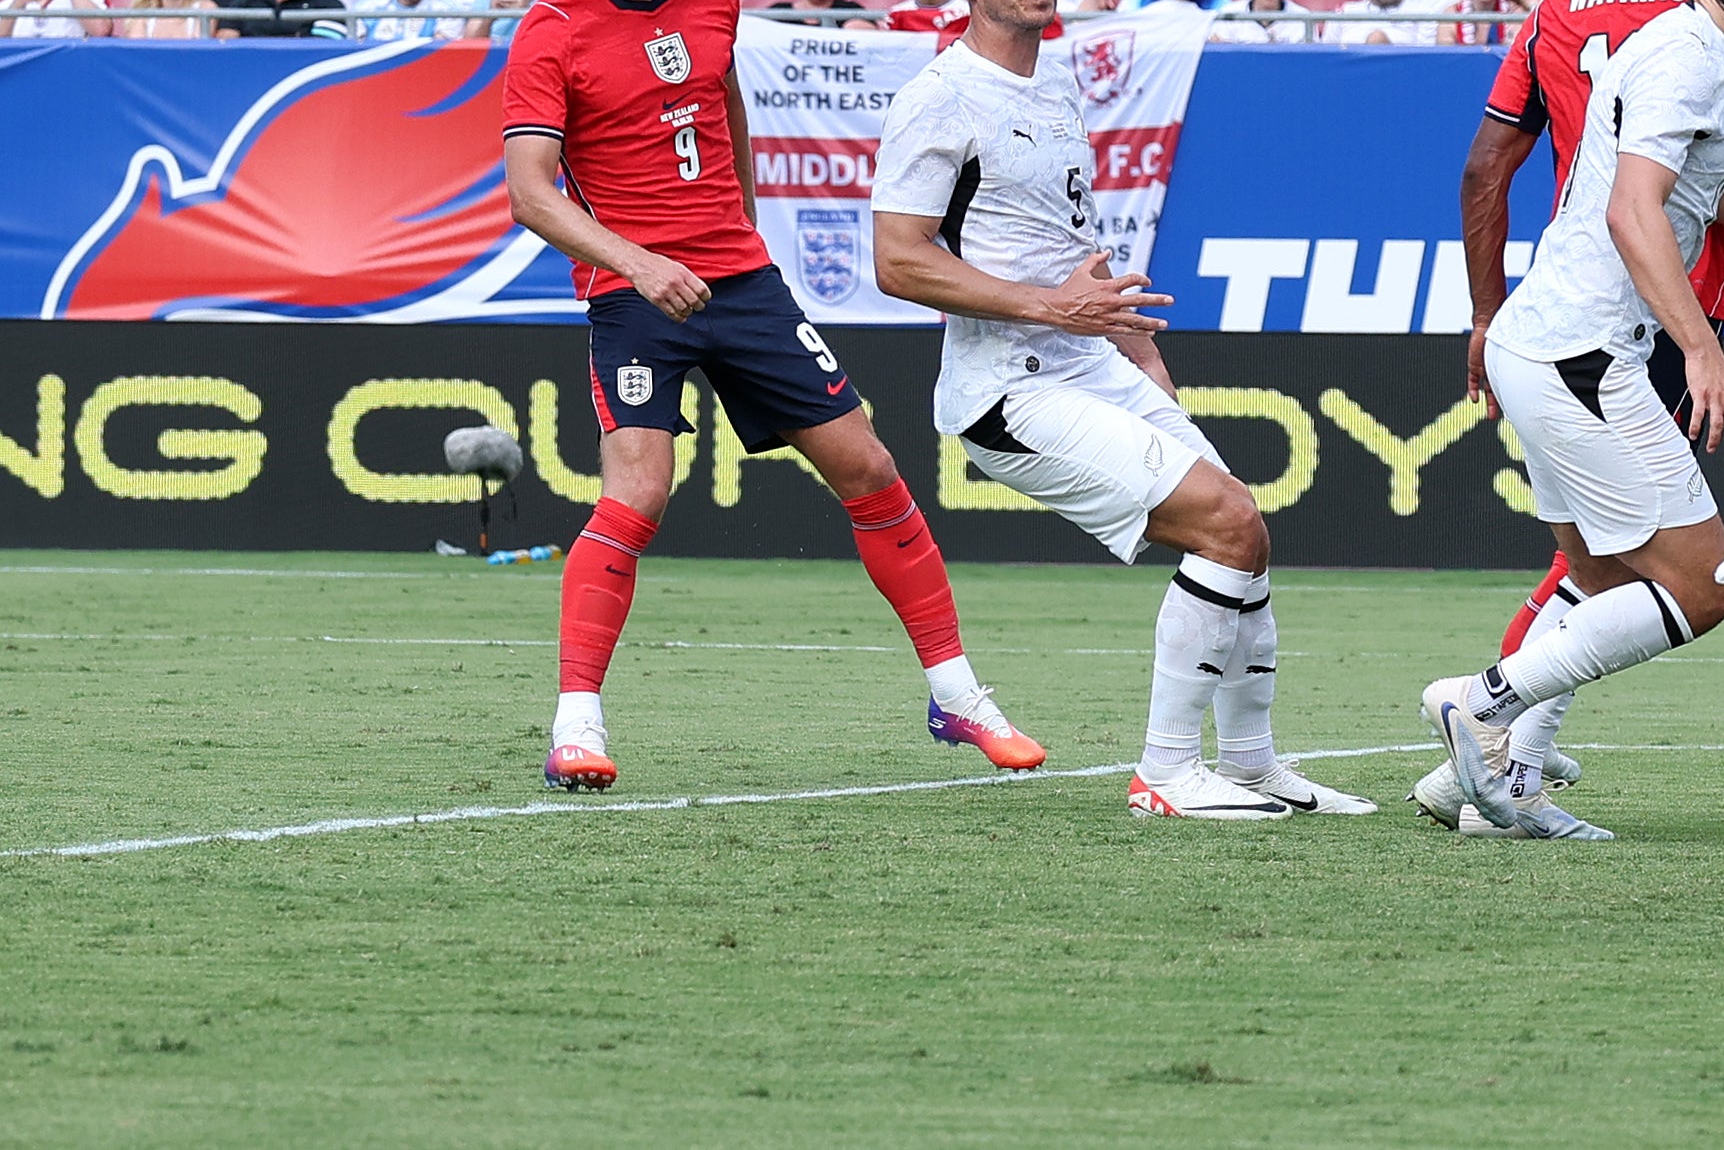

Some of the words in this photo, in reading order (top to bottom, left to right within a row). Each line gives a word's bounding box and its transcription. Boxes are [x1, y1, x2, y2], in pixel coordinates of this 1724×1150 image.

[790, 38, 858, 56] PRIDE
[783, 64, 814, 84] OF
[820, 65, 866, 84] THE
[754, 90, 833, 111] NORTH
[840, 93, 897, 111] EAST
[674, 125, 701, 181] 9
[1066, 166, 1086, 229] 5
[796, 321, 838, 372] 9
